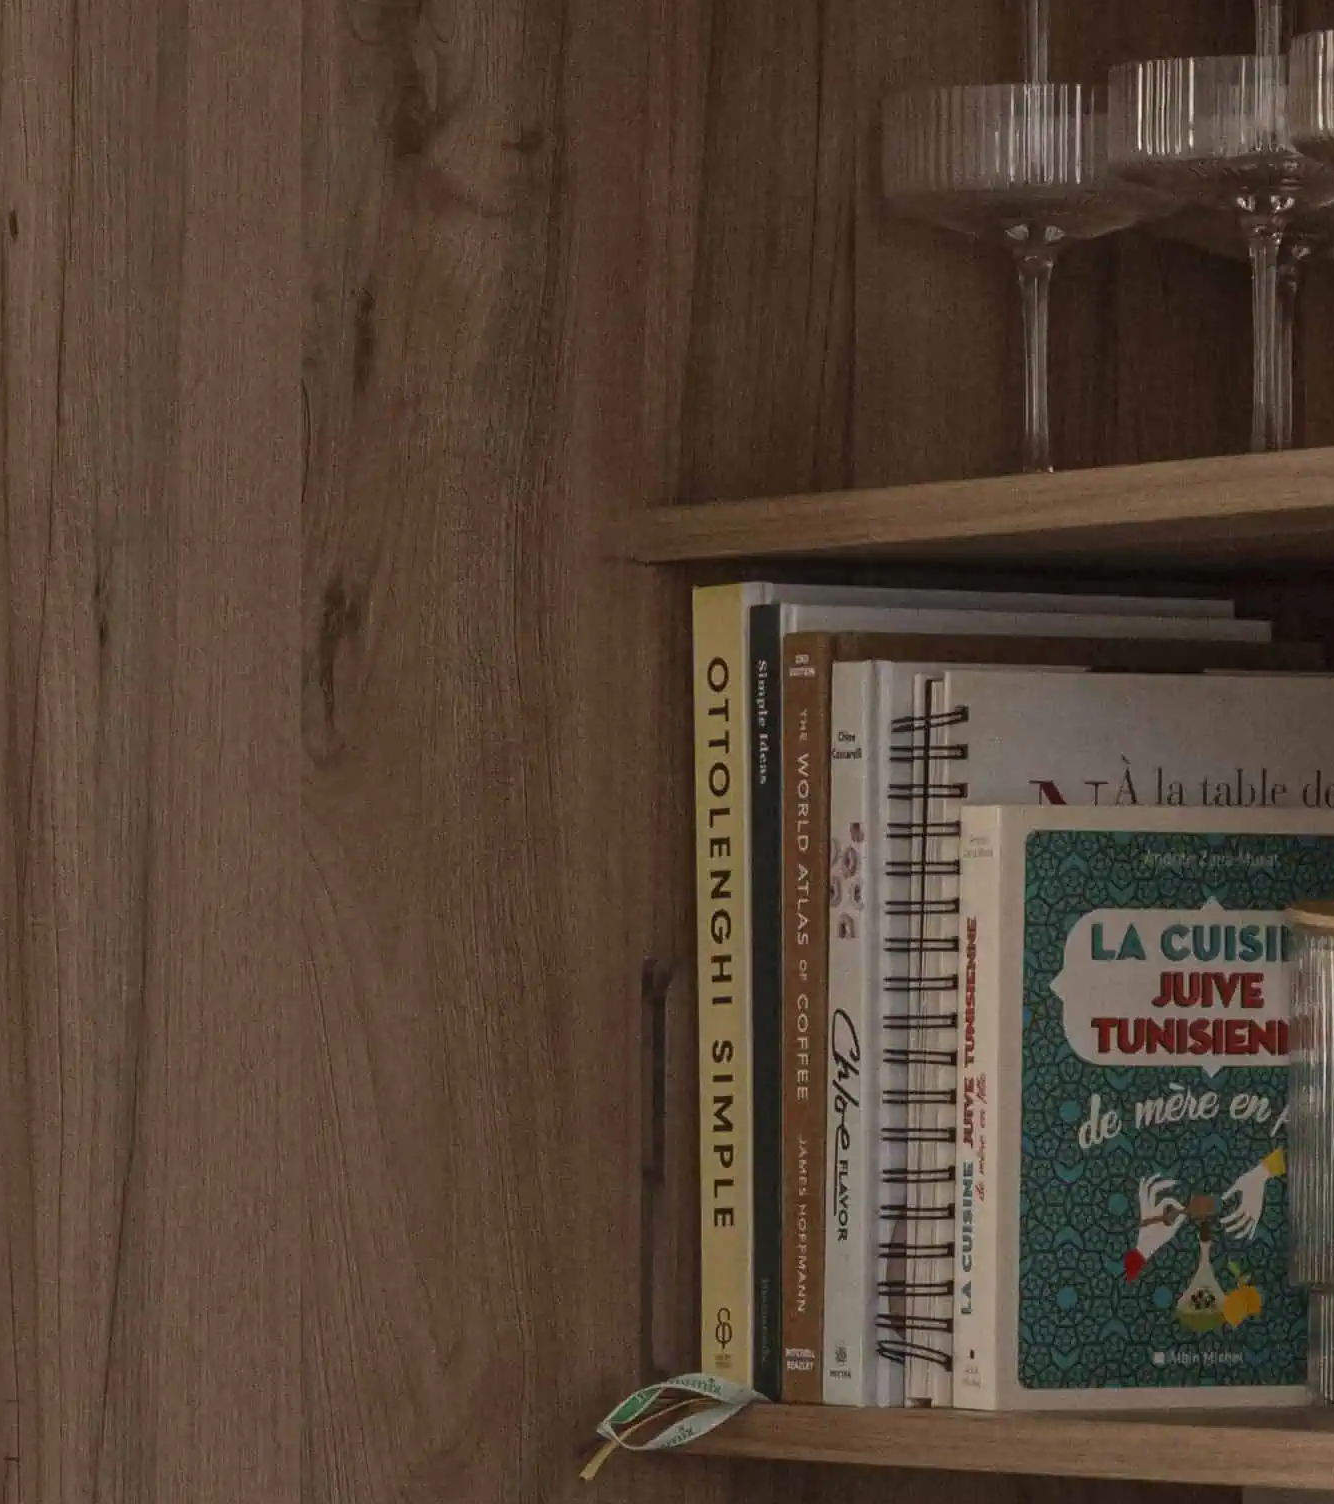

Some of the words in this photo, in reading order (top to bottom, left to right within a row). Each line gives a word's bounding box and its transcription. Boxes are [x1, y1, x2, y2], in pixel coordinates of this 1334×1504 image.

[755, 660, 768, 727] Simple
[799, 708, 808, 741] THE
[758, 733, 770, 785] Ideas
[1114, 752, 1144, 806] À
[1157, 767, 1188, 806] la
[1200, 767, 1288, 807] table
[707, 656, 733, 1005] OTTOLENGHI
[797, 753, 810, 852] WORLD
[797, 864, 810, 945] ATLAS
[1091, 923, 1147, 961] LA
[963, 916, 977, 1069] TUNISIENNE
[1151, 972, 1265, 1009] JUIVE
[797, 994, 809, 1100] COFFEE
[711, 1039, 736, 1228] SIMPLE
[963, 1076, 975, 1149] JUIVE
[1078, 1093, 1122, 1149] de
[1135, 1082, 1221, 1129] mère
[1230, 1092, 1271, 1123] en
[798, 1135, 809, 1196] JAMES
[836, 1159, 850, 1243] FLAVOR
[961, 1161, 975, 1273] CUISINE
[796, 1205, 808, 1313] HOFFMANN
[961, 1281, 974, 1315] LA
